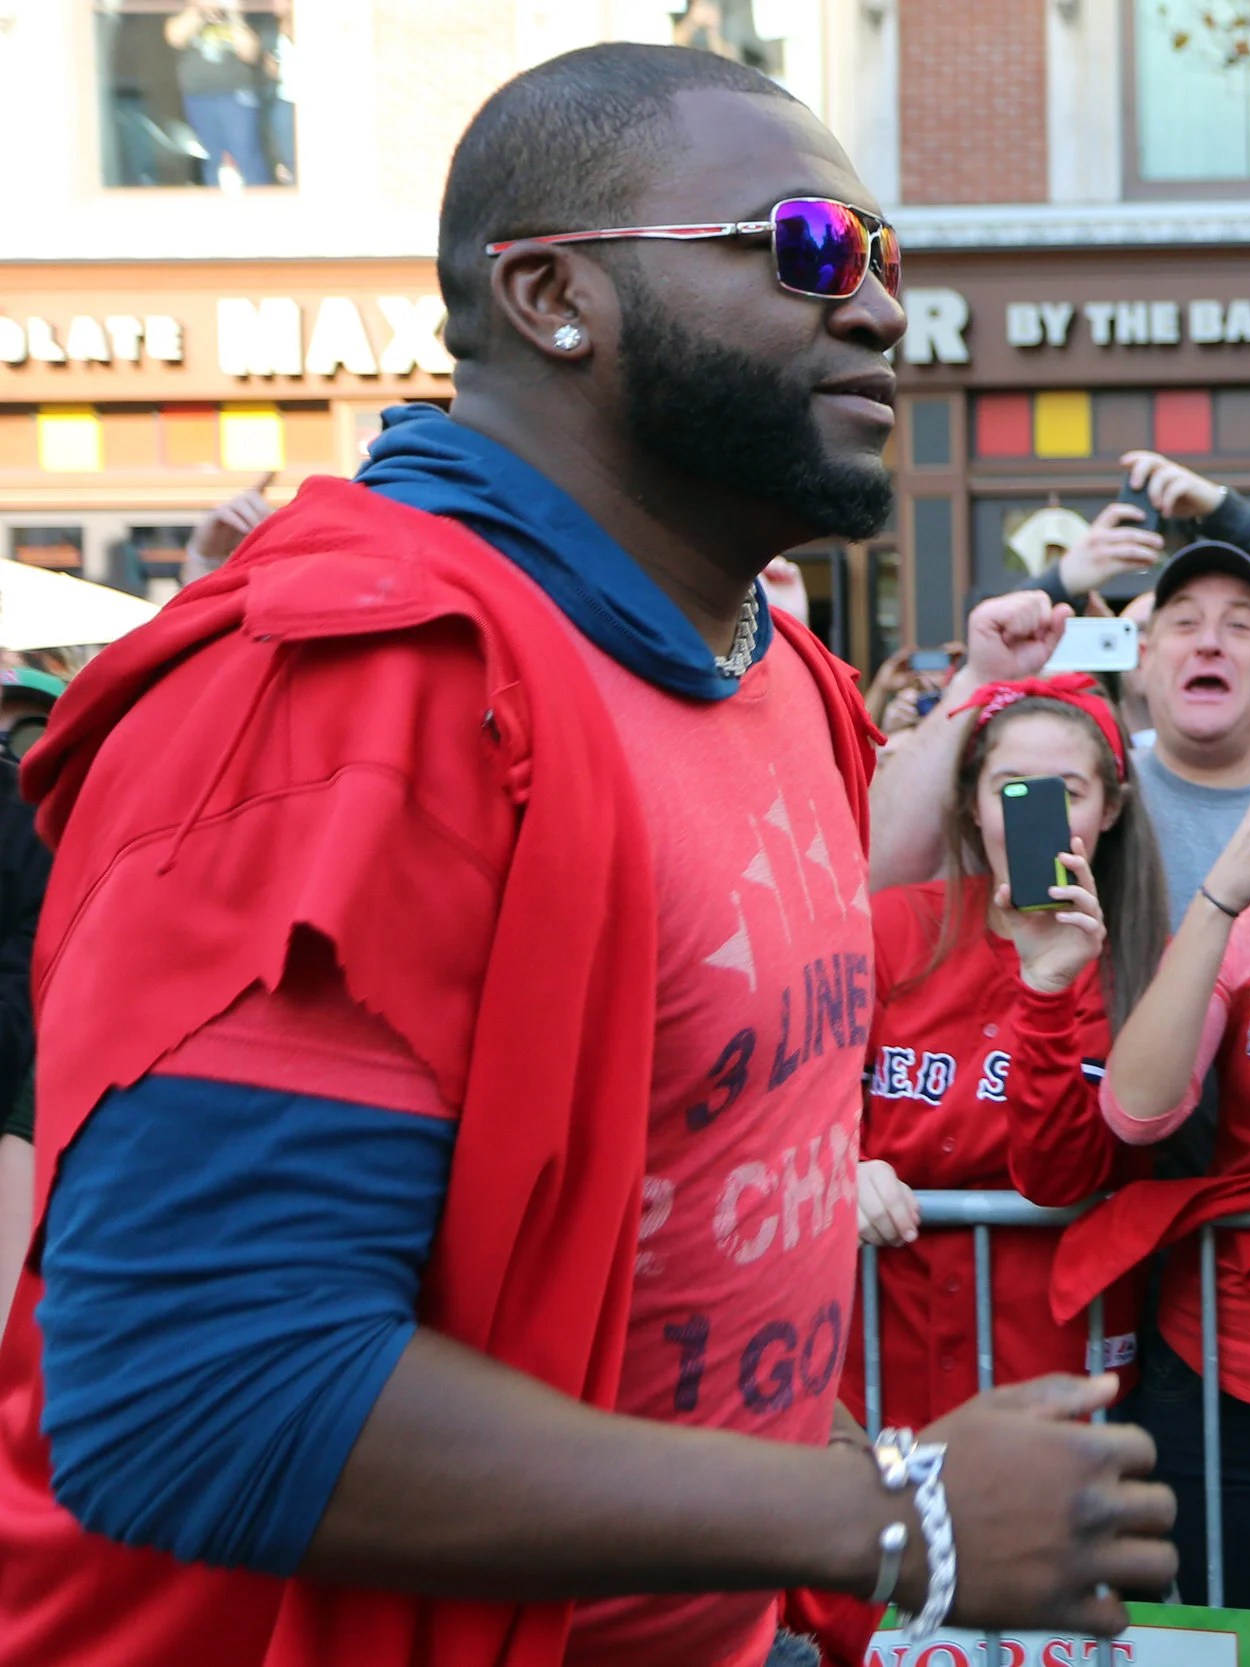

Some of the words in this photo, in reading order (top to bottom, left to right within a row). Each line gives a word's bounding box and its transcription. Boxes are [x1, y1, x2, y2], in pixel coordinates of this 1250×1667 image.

[884, 288, 969, 365] R
[1006, 302, 1073, 347] BY
[1085, 302, 1180, 344] THE
[686, 1027, 756, 1131] 3
[712, 1112, 862, 1266] CHA
[664, 1313, 710, 1413] 1
